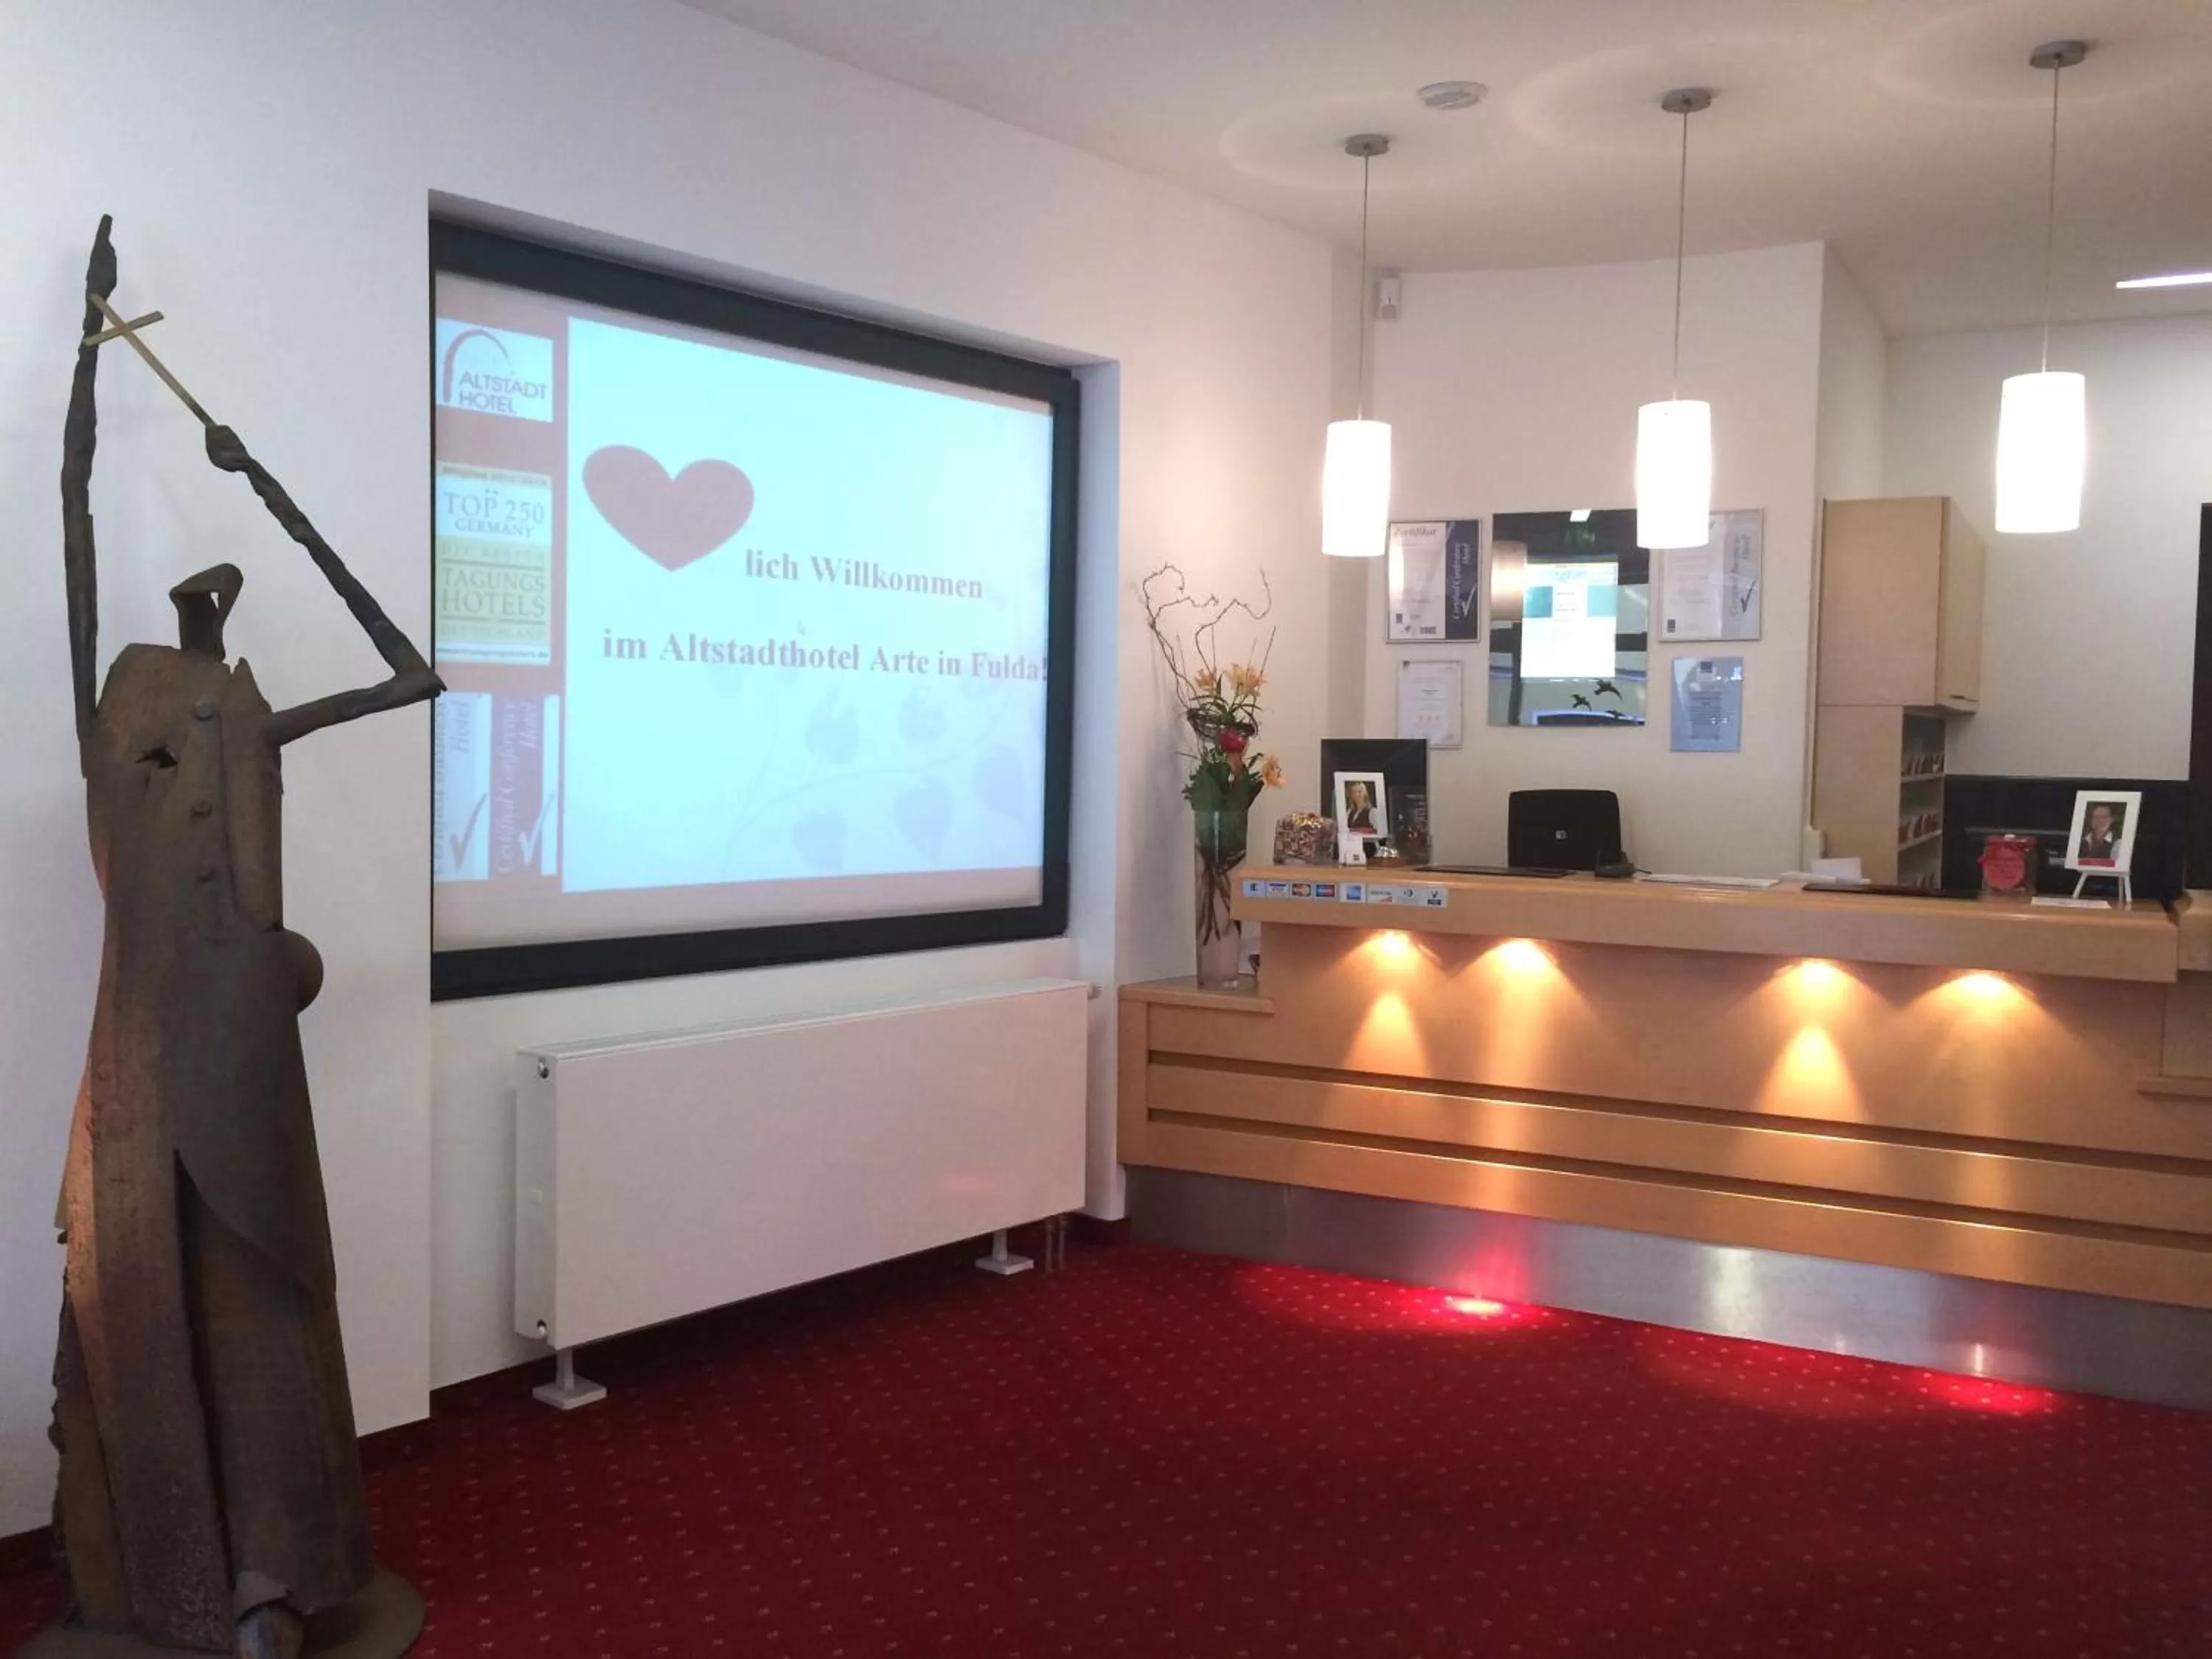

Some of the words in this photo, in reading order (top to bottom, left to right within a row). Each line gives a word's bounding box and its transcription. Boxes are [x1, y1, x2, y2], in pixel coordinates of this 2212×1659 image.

[459, 370, 548, 400] ALTSTADT
[459, 390, 518, 414] HOTEL
[505, 499, 544, 524] 250
[453, 518, 535, 538] GERMANY
[444, 568, 546, 592] TAGUNGS
[745, 548, 799, 580] lich
[810, 554, 984, 599] Willkommen
[442, 588, 546, 619] HOTELS
[603, 627, 647, 660] im
[659, 632, 860, 670] Altstadthotel
[869, 646, 930, 674] Arte
[938, 650, 961, 676] in
[971, 651, 1047, 681] Fulda!
